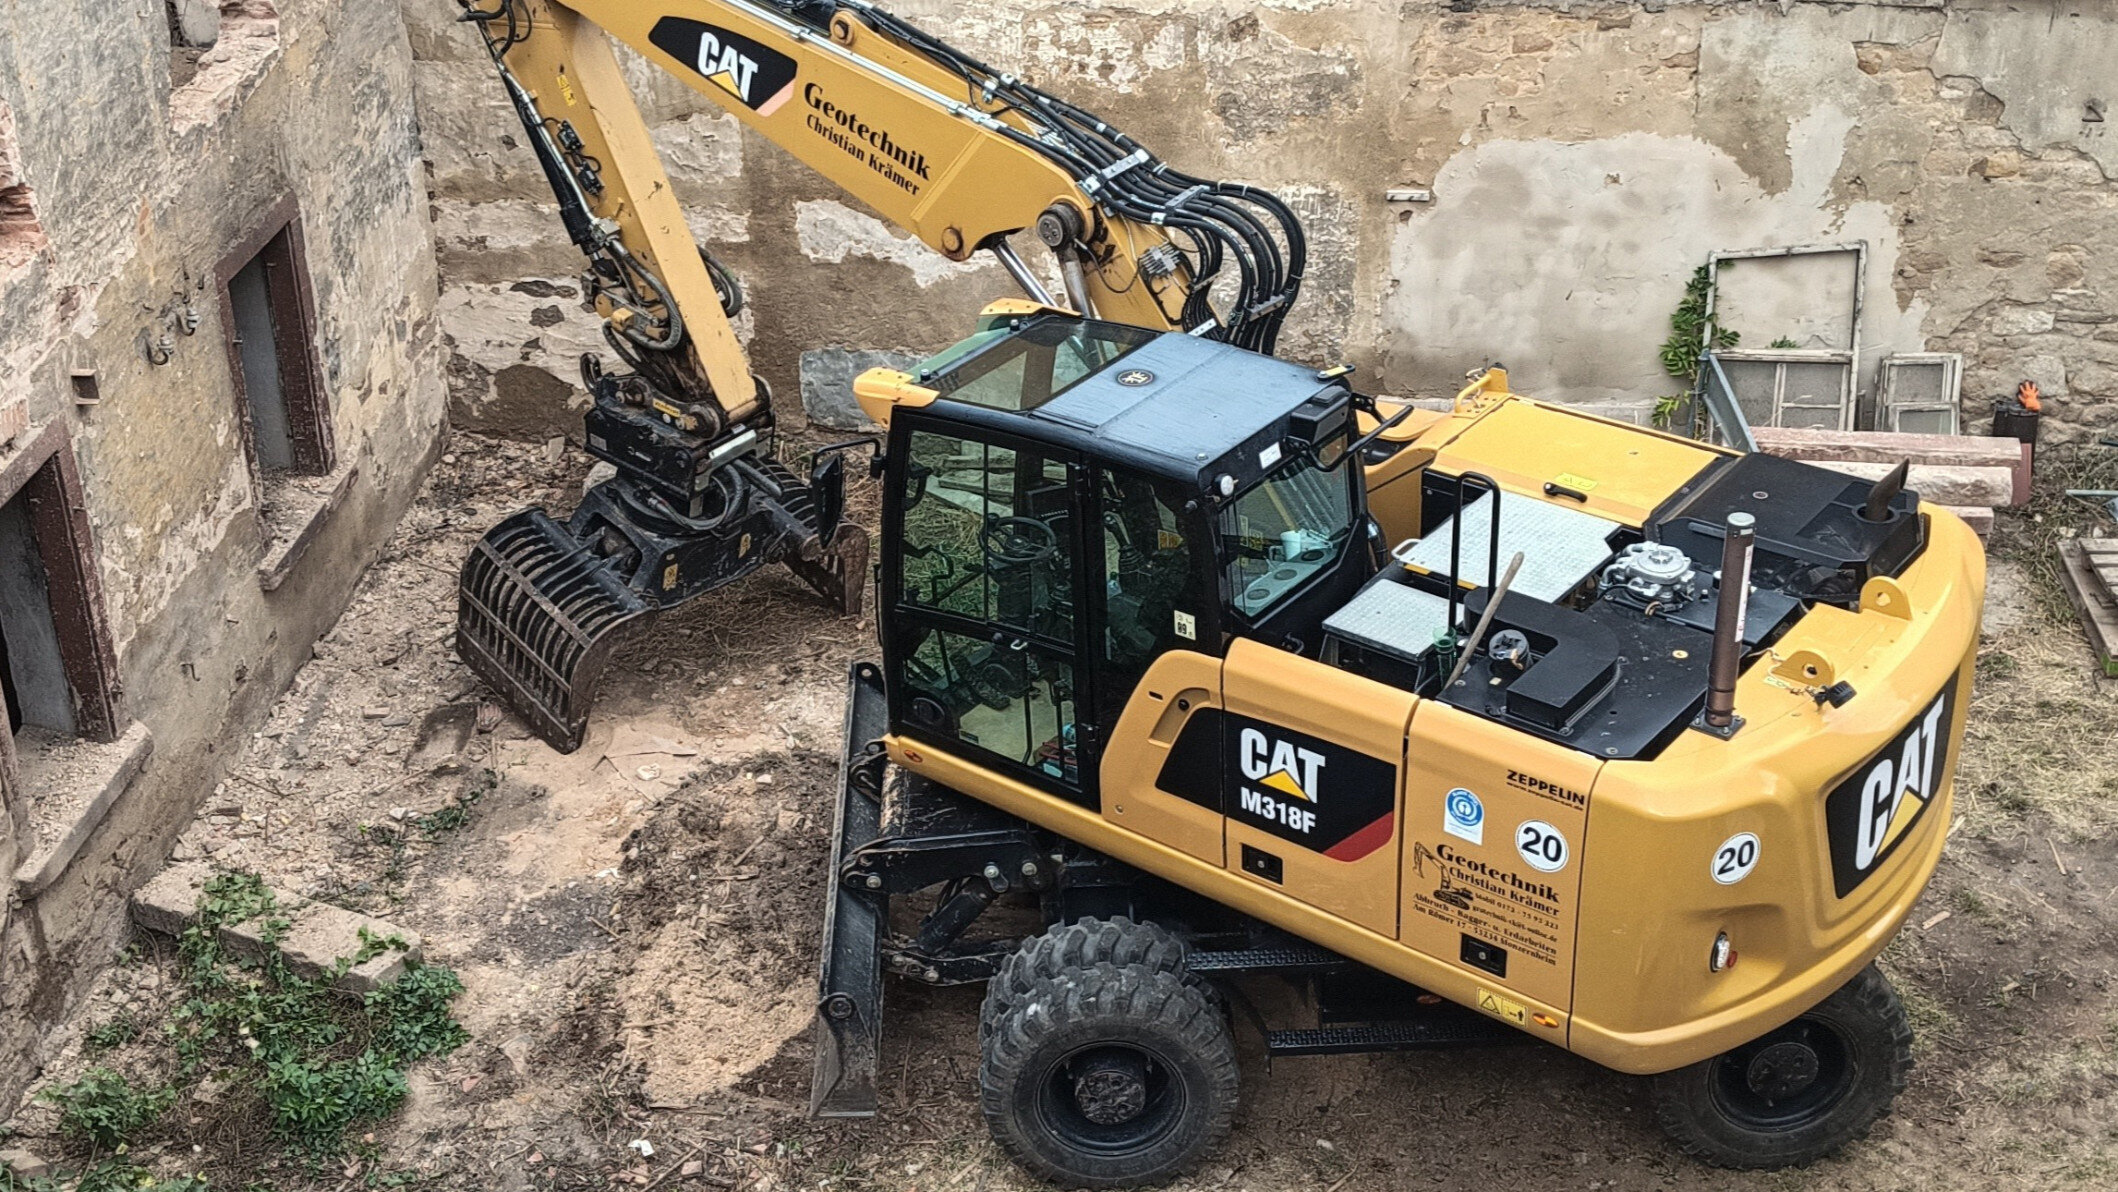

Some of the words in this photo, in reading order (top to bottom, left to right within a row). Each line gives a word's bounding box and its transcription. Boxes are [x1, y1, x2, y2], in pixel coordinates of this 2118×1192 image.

[698, 31, 759, 102] CAT
[804, 82, 931, 181] Geotechnik
[806, 114, 865, 161] Christian
[868, 152, 920, 195] Krämer
[1240, 727, 1326, 804] CAT
[1506, 769, 1585, 805] ZEPPELIN
[1855, 693, 1945, 871] CAT
[1240, 787, 1316, 834] M318F
[1436, 844, 1560, 904] Geotechnik
[1521, 826, 1562, 862] 20
[1717, 840, 1755, 876] 20
[1449, 867, 1506, 896] Christian
[1510, 890, 1560, 916] Krämer
[1413, 892, 1450, 912] Abbruch
[1503, 928, 1557, 956] Erdarbeiten
